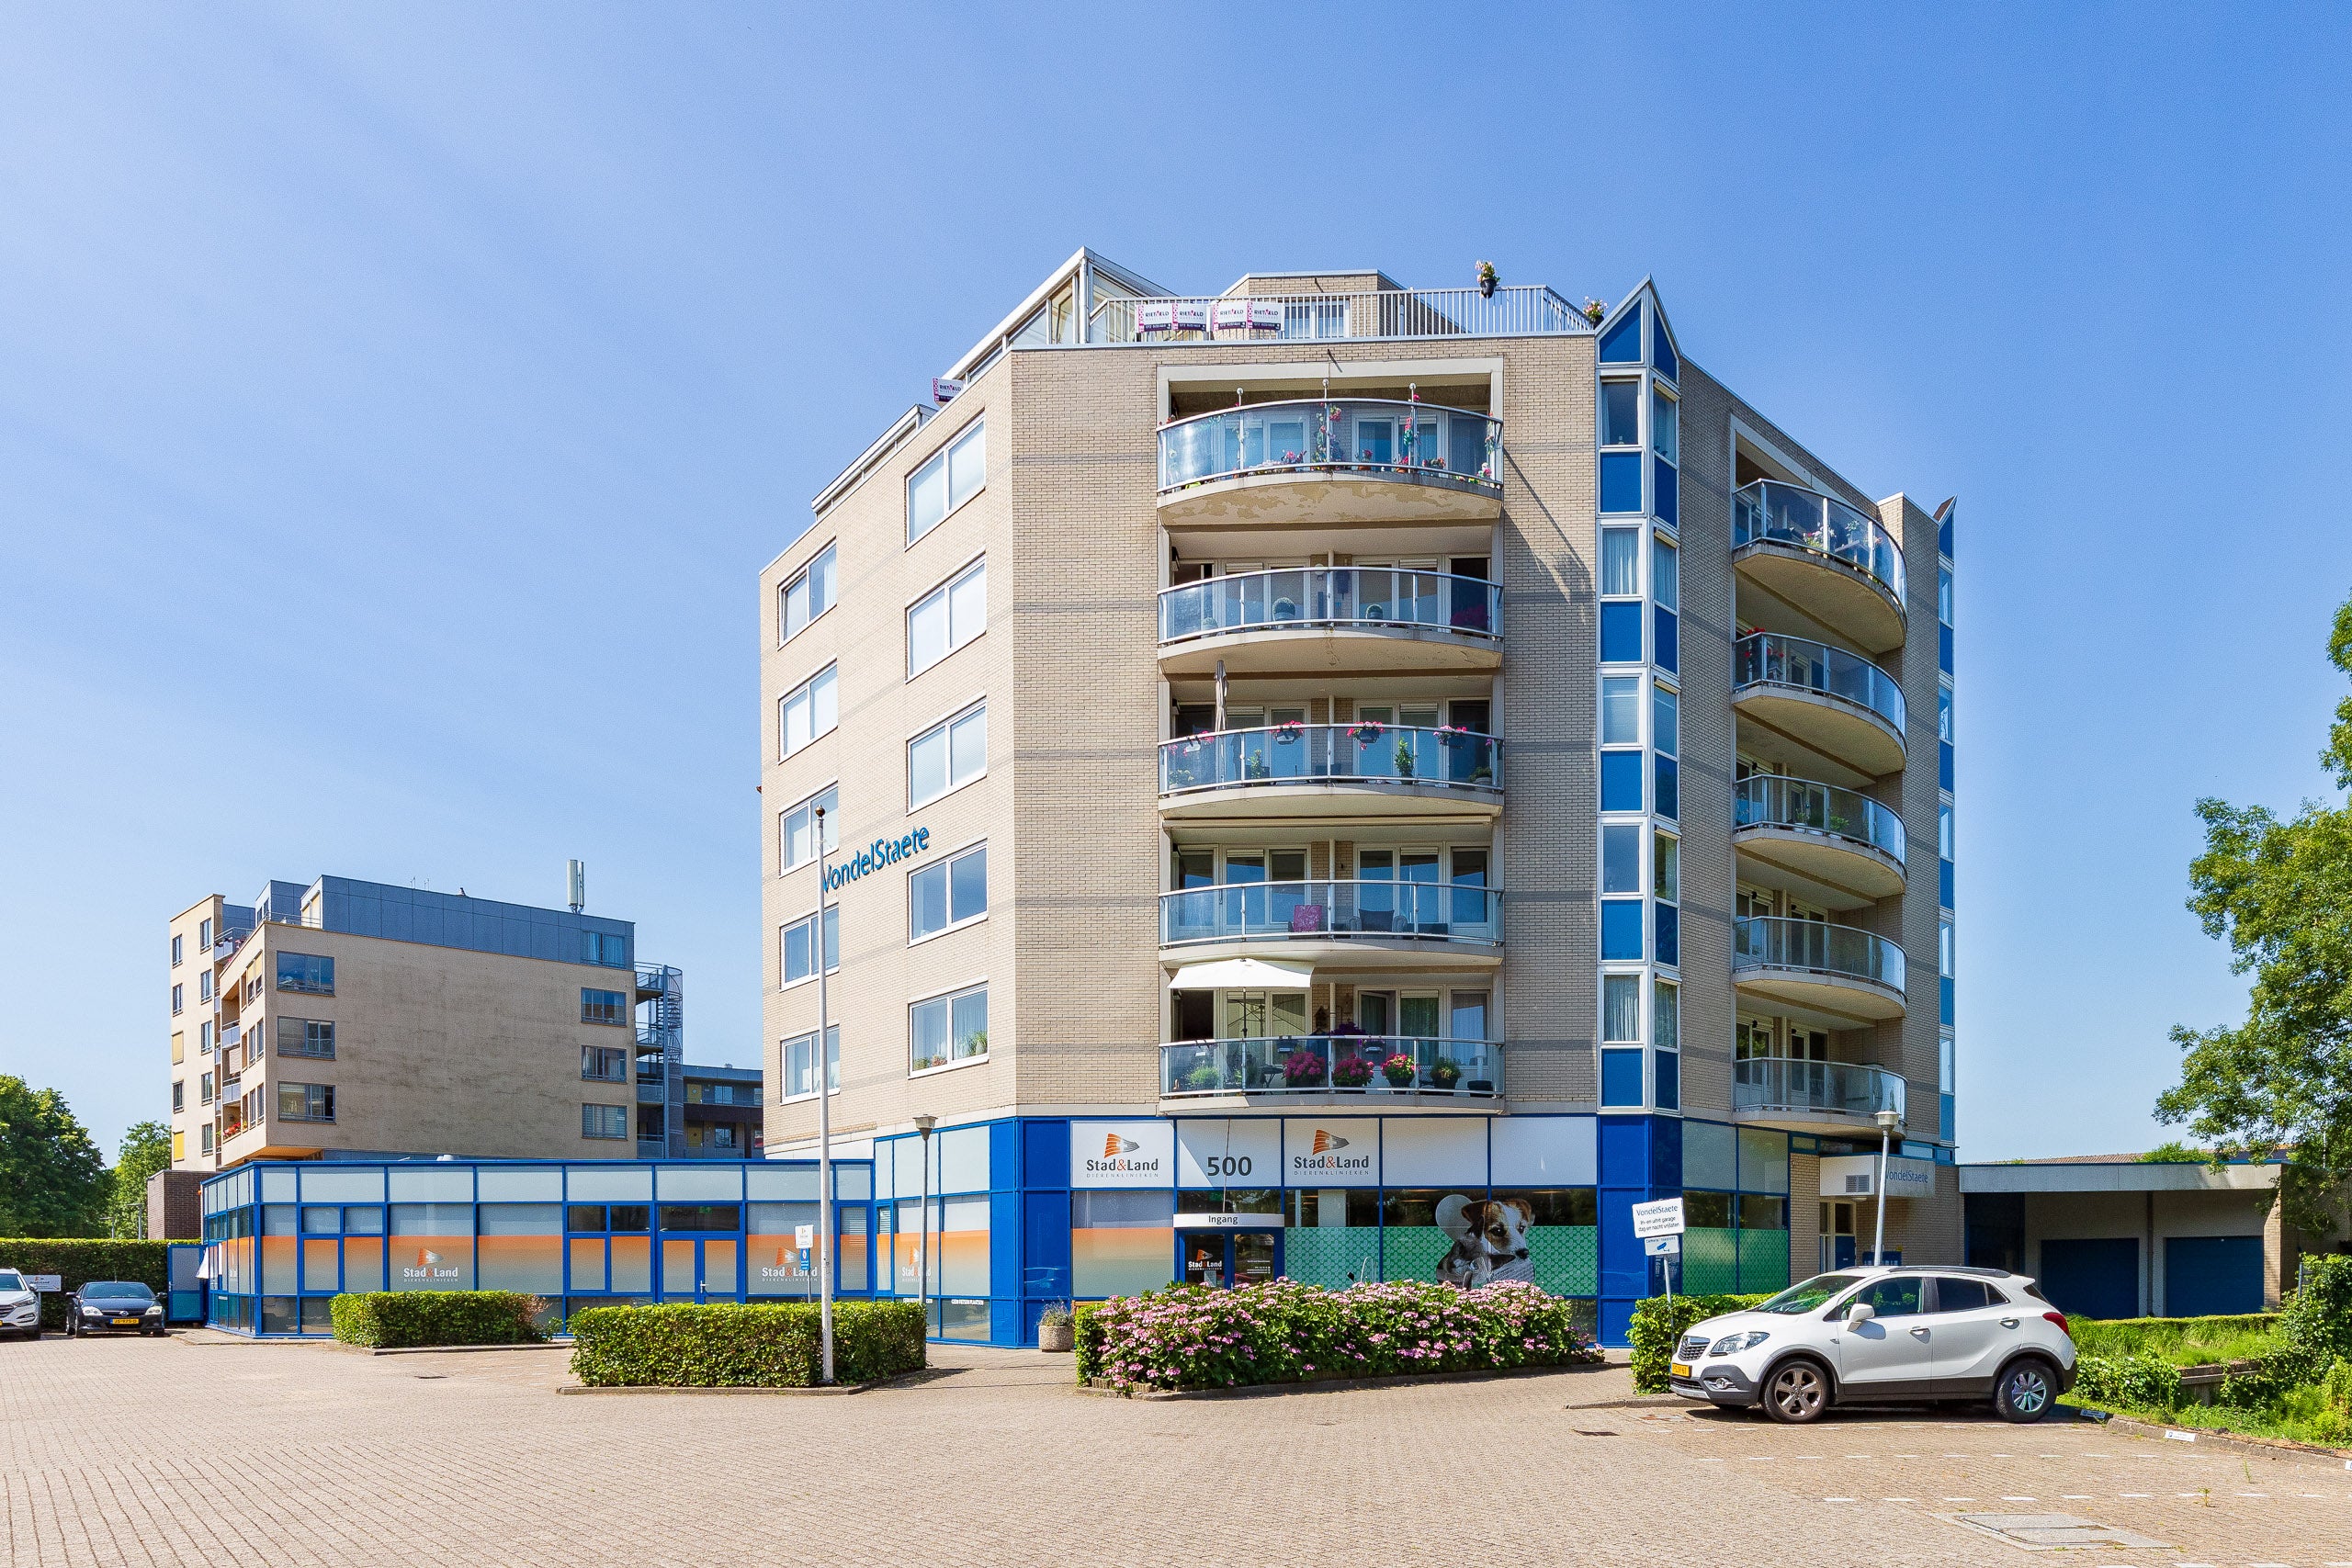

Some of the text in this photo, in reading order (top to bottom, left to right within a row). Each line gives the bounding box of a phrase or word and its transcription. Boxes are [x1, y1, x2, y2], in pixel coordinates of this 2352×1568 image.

[823, 826, 930, 894] VondelStaete
[1086, 1158, 1159, 1171] Stad&Land
[1207, 1156, 1252, 1177] 500
[1294, 1156, 1369, 1168] Stad&Land
[1636, 1205, 1679, 1216] VondelStaete
[1208, 1215, 1238, 1224] Ingang
[1188, 1260, 1223, 1269] Stad&Land
[403, 1268, 458, 1278] Stad&Land
